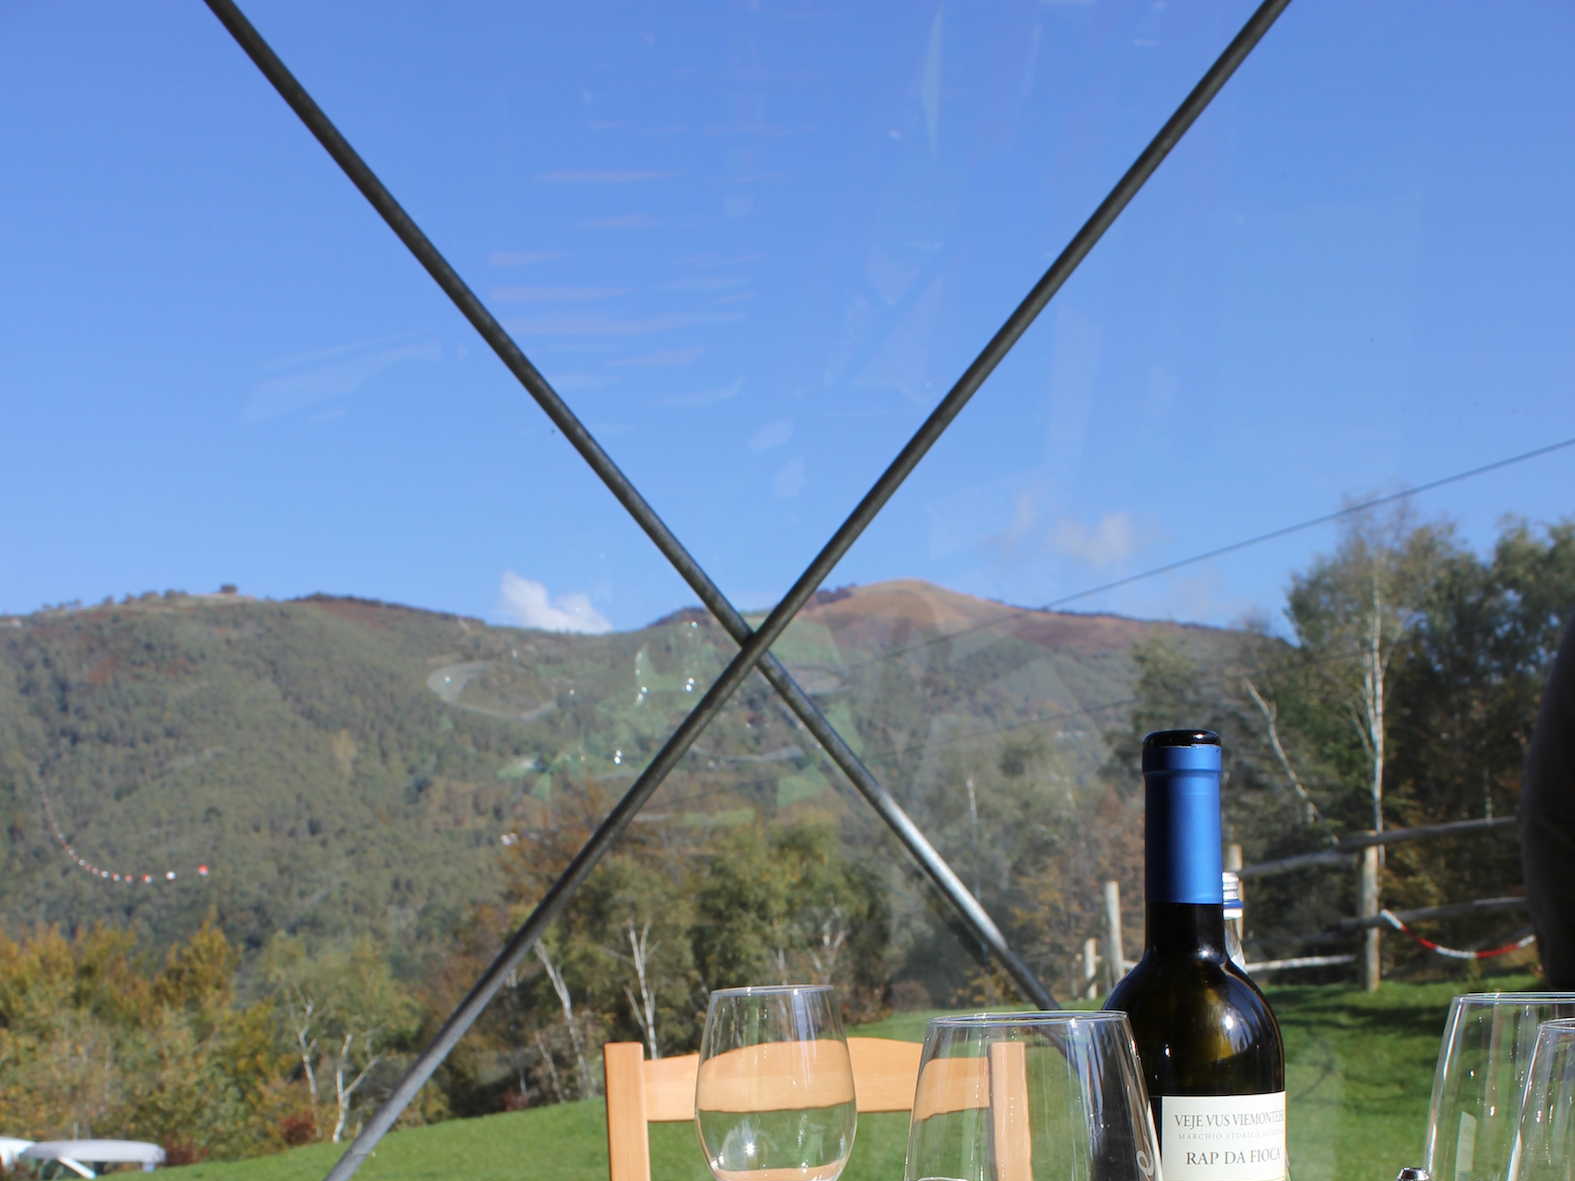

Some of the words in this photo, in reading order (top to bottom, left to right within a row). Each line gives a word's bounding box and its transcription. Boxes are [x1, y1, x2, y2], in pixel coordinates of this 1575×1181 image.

[1174, 1114, 1204, 1130] VEJE
[1186, 1151, 1219, 1166] RAP
[1224, 1150, 1246, 1165] DA
